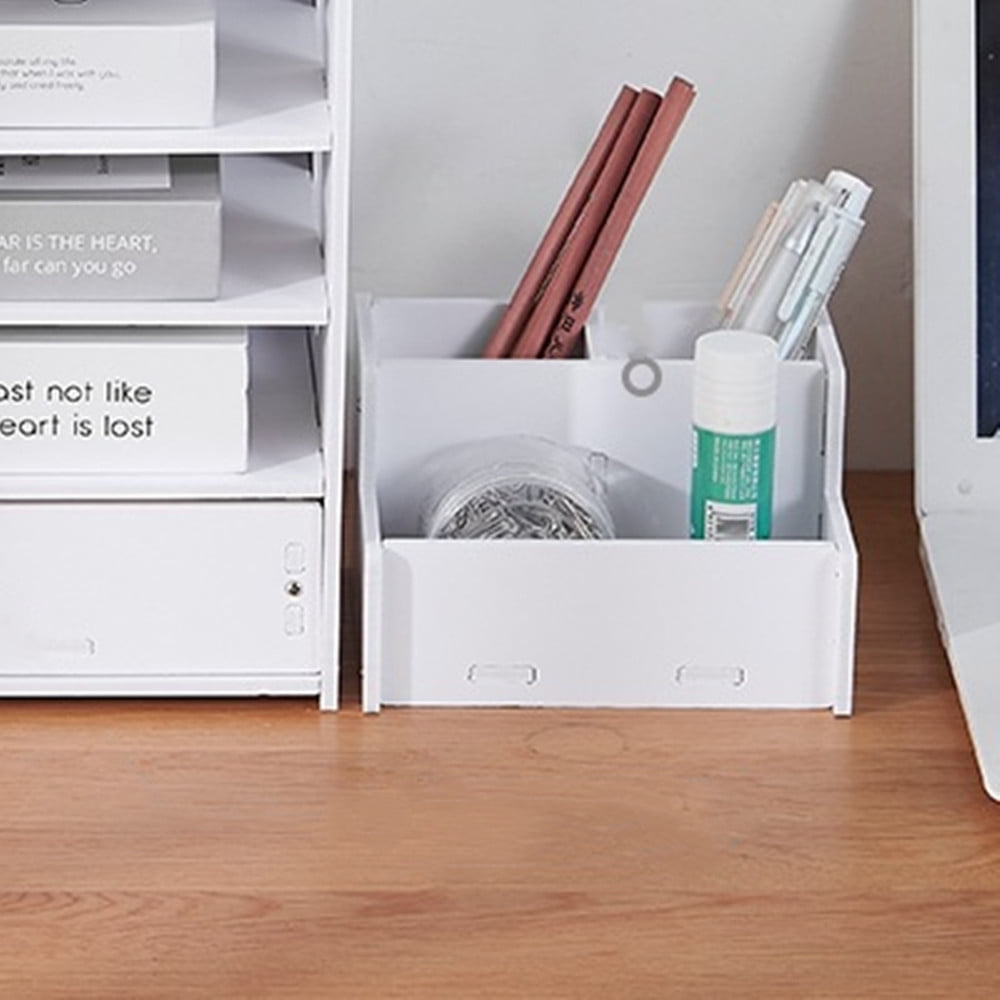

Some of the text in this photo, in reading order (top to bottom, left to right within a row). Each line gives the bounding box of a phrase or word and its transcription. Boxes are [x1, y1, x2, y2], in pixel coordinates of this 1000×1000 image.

[26, 234, 43, 250] IS
[48, 234, 85, 251] THE
[91, 234, 158, 254] HEART,
[3, 256, 29, 274] far
[34, 260, 67, 274] can
[71, 260, 107, 278] you
[111, 261, 137, 279] go
[46, 382, 94, 403] not
[105, 379, 153, 405] like
[73, 412, 93, 438] is
[103, 414, 154, 439] lost
